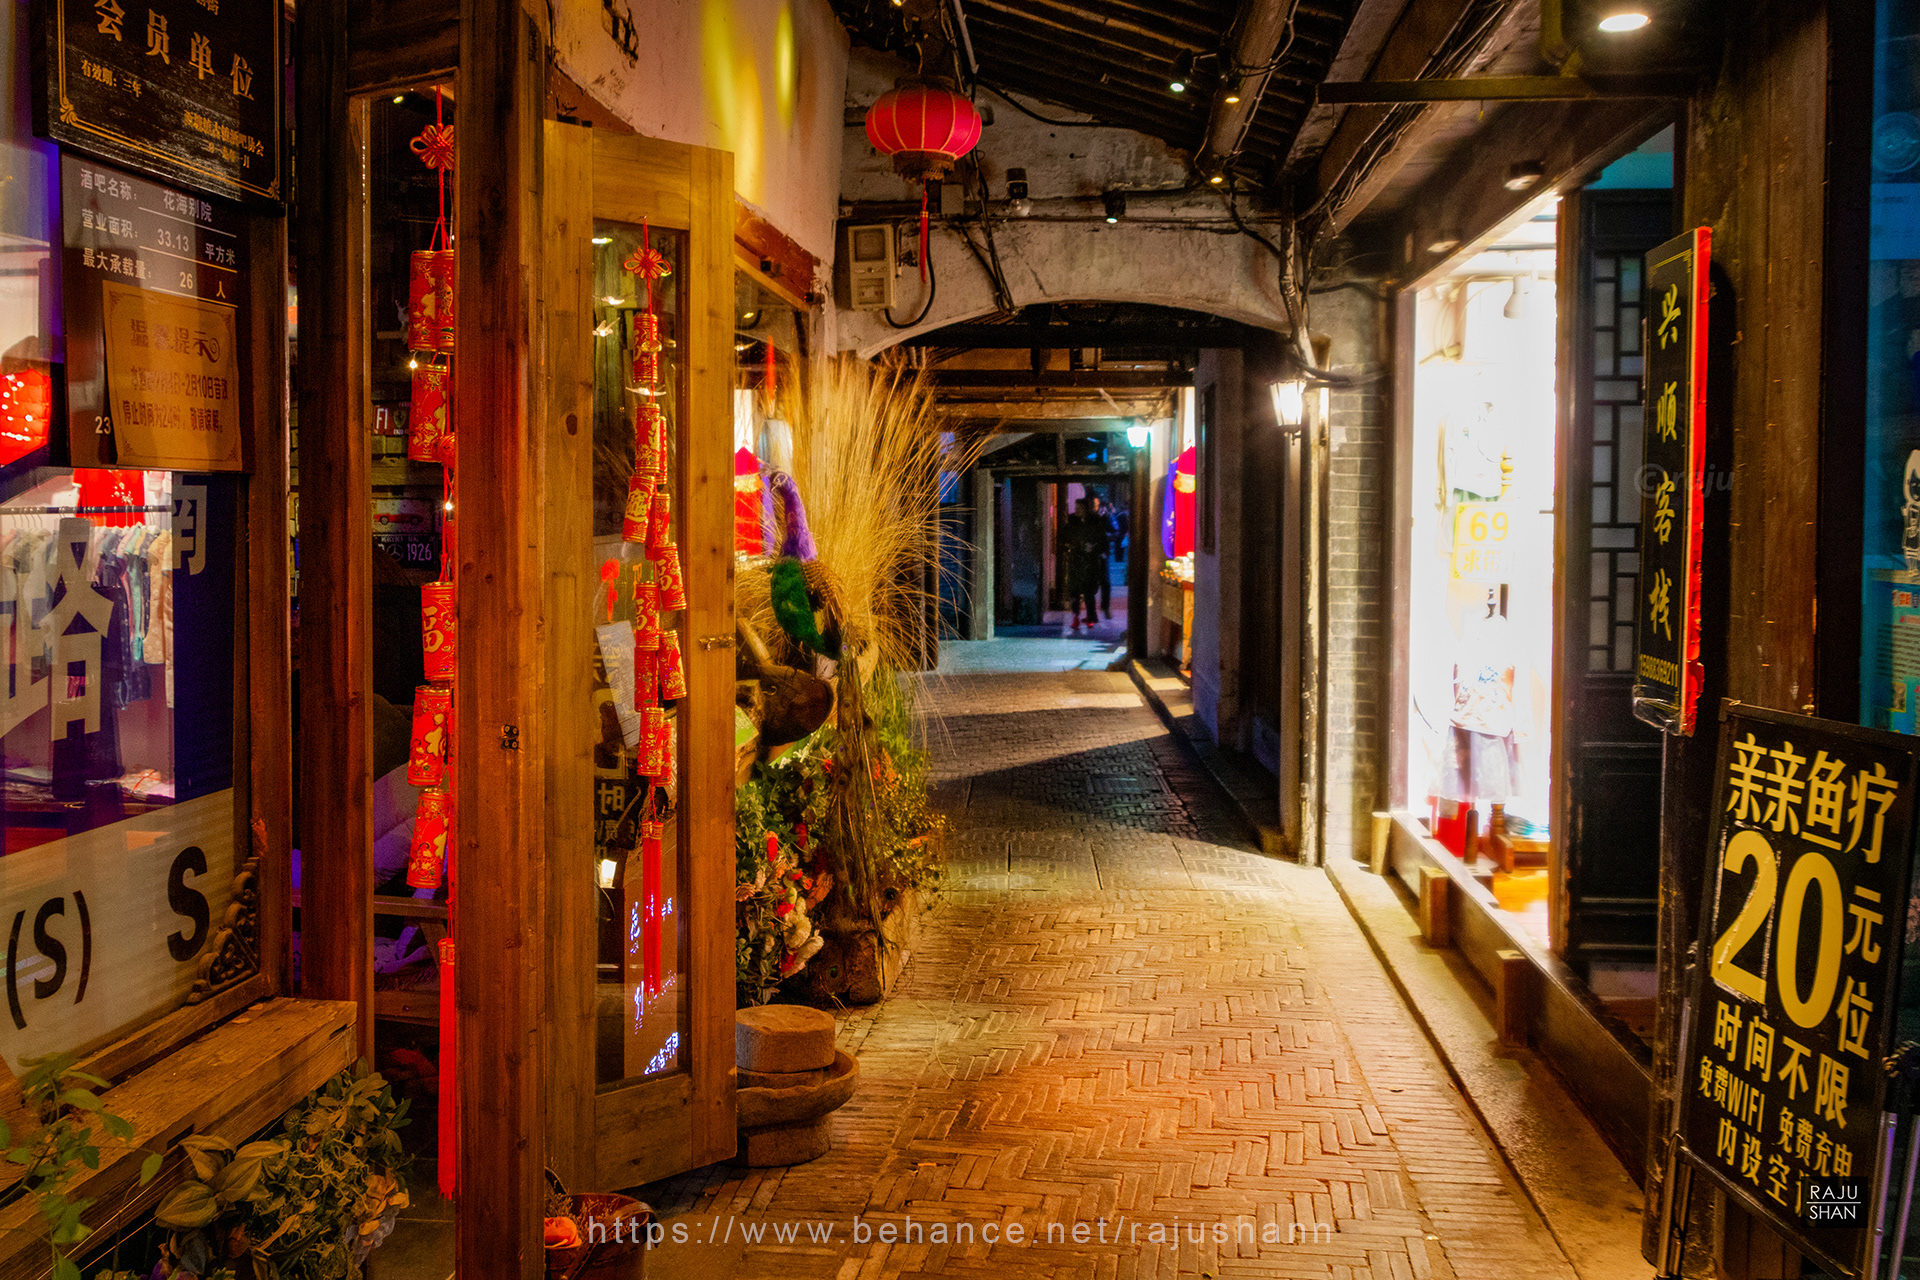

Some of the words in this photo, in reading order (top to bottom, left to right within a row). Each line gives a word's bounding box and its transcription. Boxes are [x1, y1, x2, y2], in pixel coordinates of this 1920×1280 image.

[93, 0, 255, 101] 会员单位
[81, 168, 137, 201] 酒吧名称:
[163, 189, 213, 222] 花海别院
[81, 209, 138, 239] 营业面积:
[157, 228, 190, 252] 33.13
[205, 242, 236, 265] 平方米
[179, 271, 194, 289] 26
[216, 281, 226, 299] 人
[95, 415, 112, 435] 23
[406, 543, 433, 561] 1926
[1469, 511, 1510, 543] 69
[1726, 732, 1899, 864] 亲亲鱼疗
[6, 890, 92, 1030] (S)
[167, 846, 211, 962] S
[1710, 828, 1844, 1029] 20
[1714, 1000, 1850, 1129] 时间不限
[1698, 1055, 1765, 1133] 免费WIFI
[1776, 1106, 1853, 1178] 免费充电
